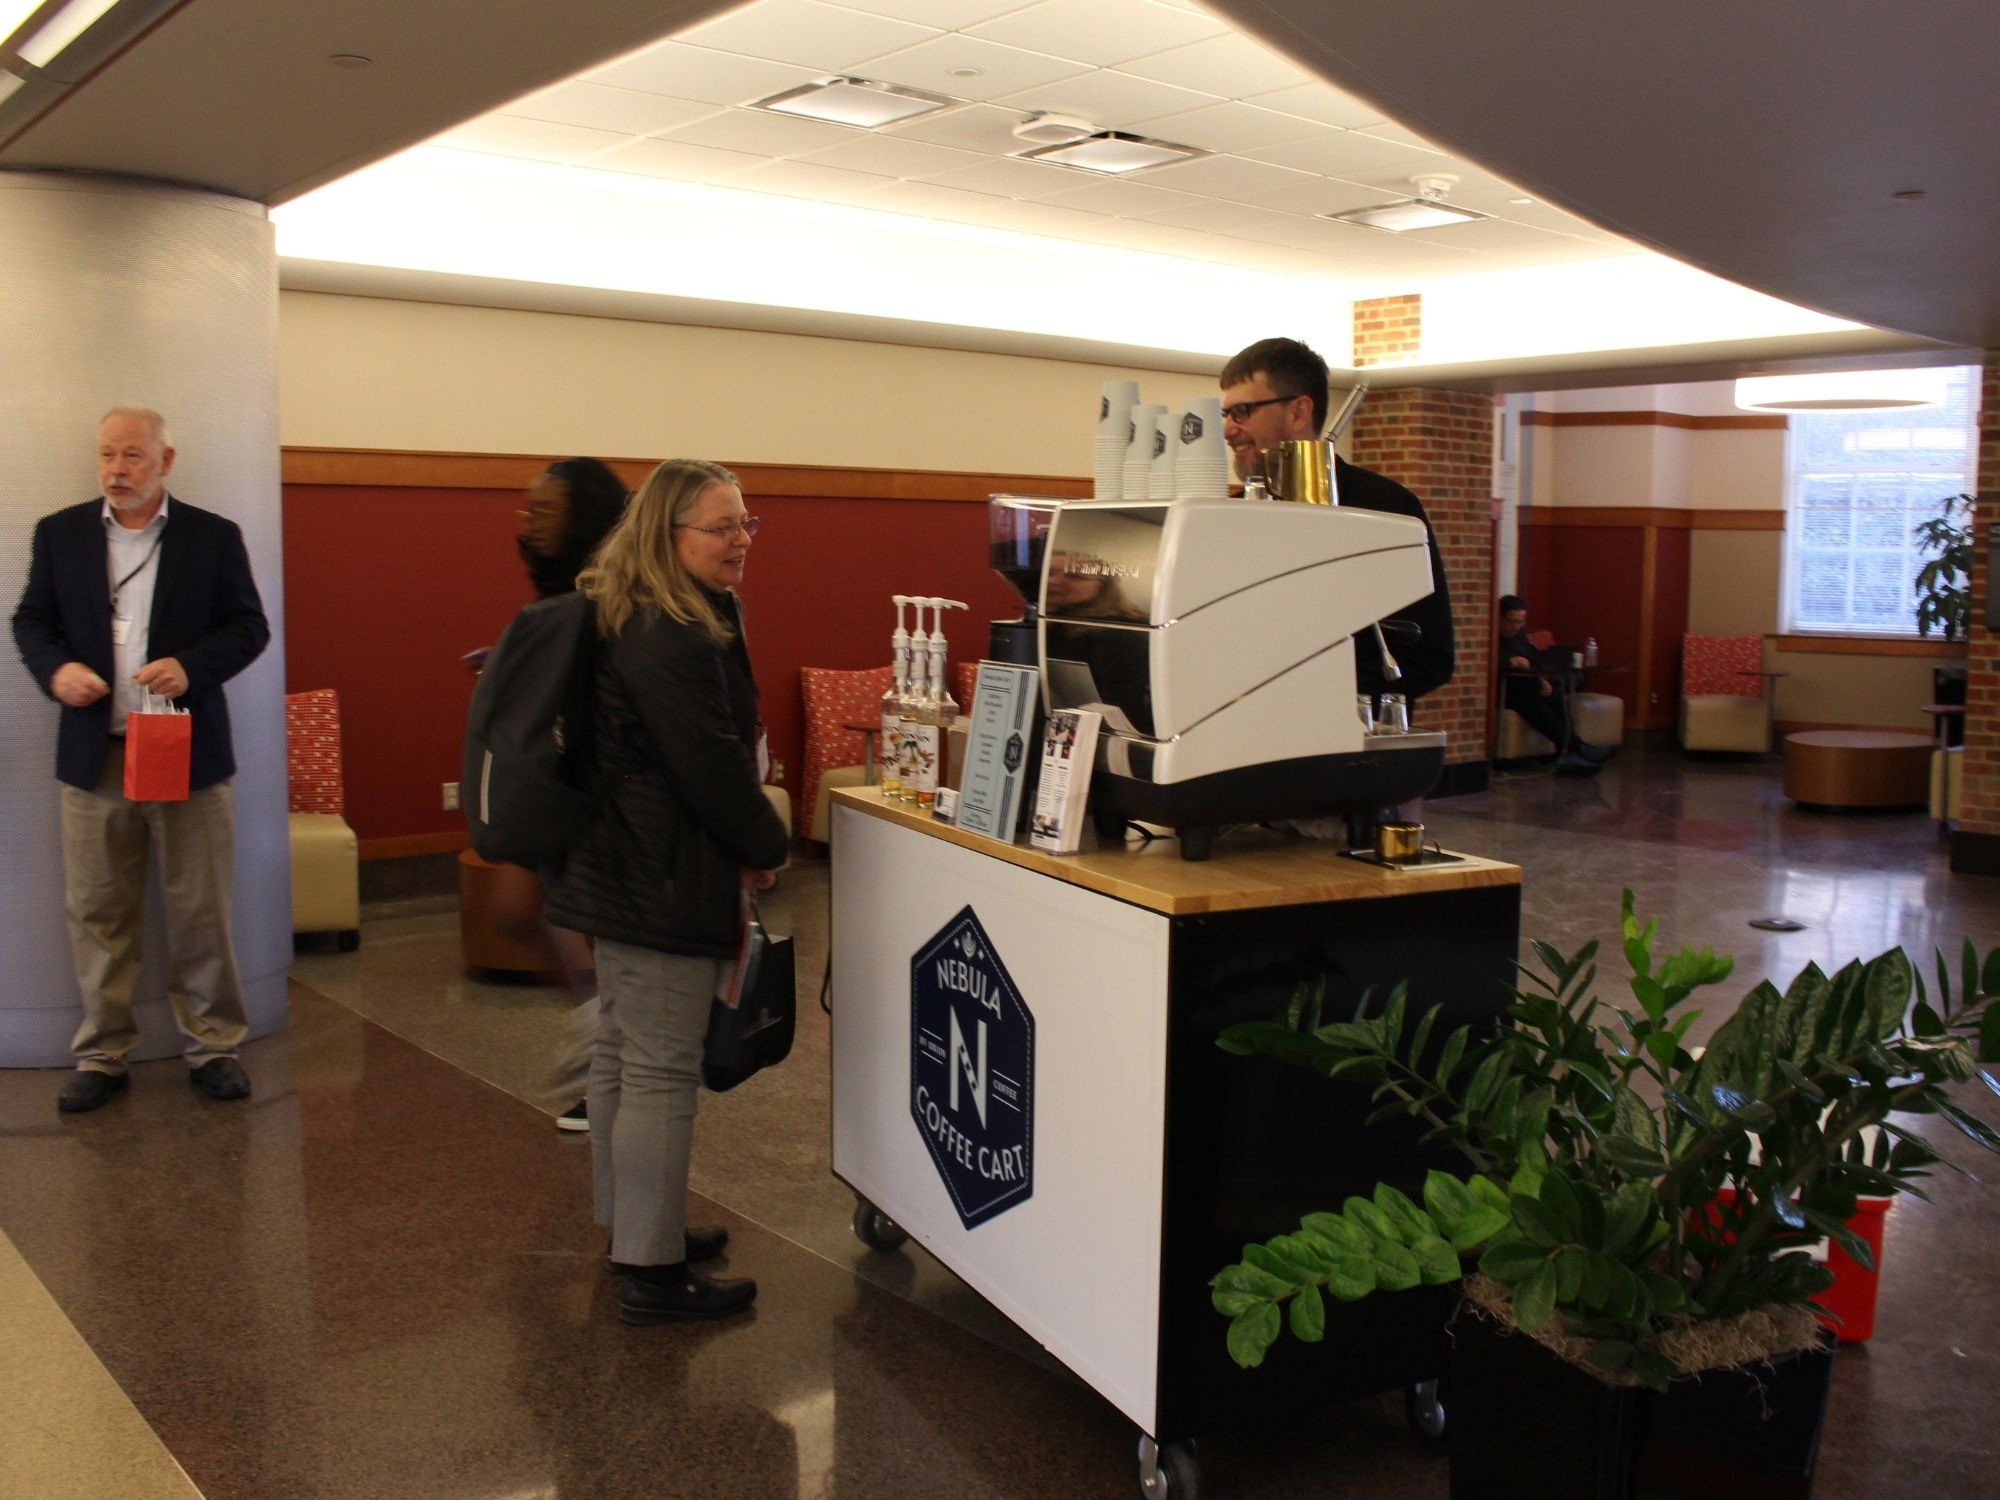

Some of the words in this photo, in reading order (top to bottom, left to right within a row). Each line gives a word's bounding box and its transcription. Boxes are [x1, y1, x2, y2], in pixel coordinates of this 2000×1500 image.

[936, 958, 1001, 1021] NEBULA
[950, 1004, 987, 1131] N
[917, 1085, 973, 1171] COFFEE
[978, 1144, 1024, 1182] CART
